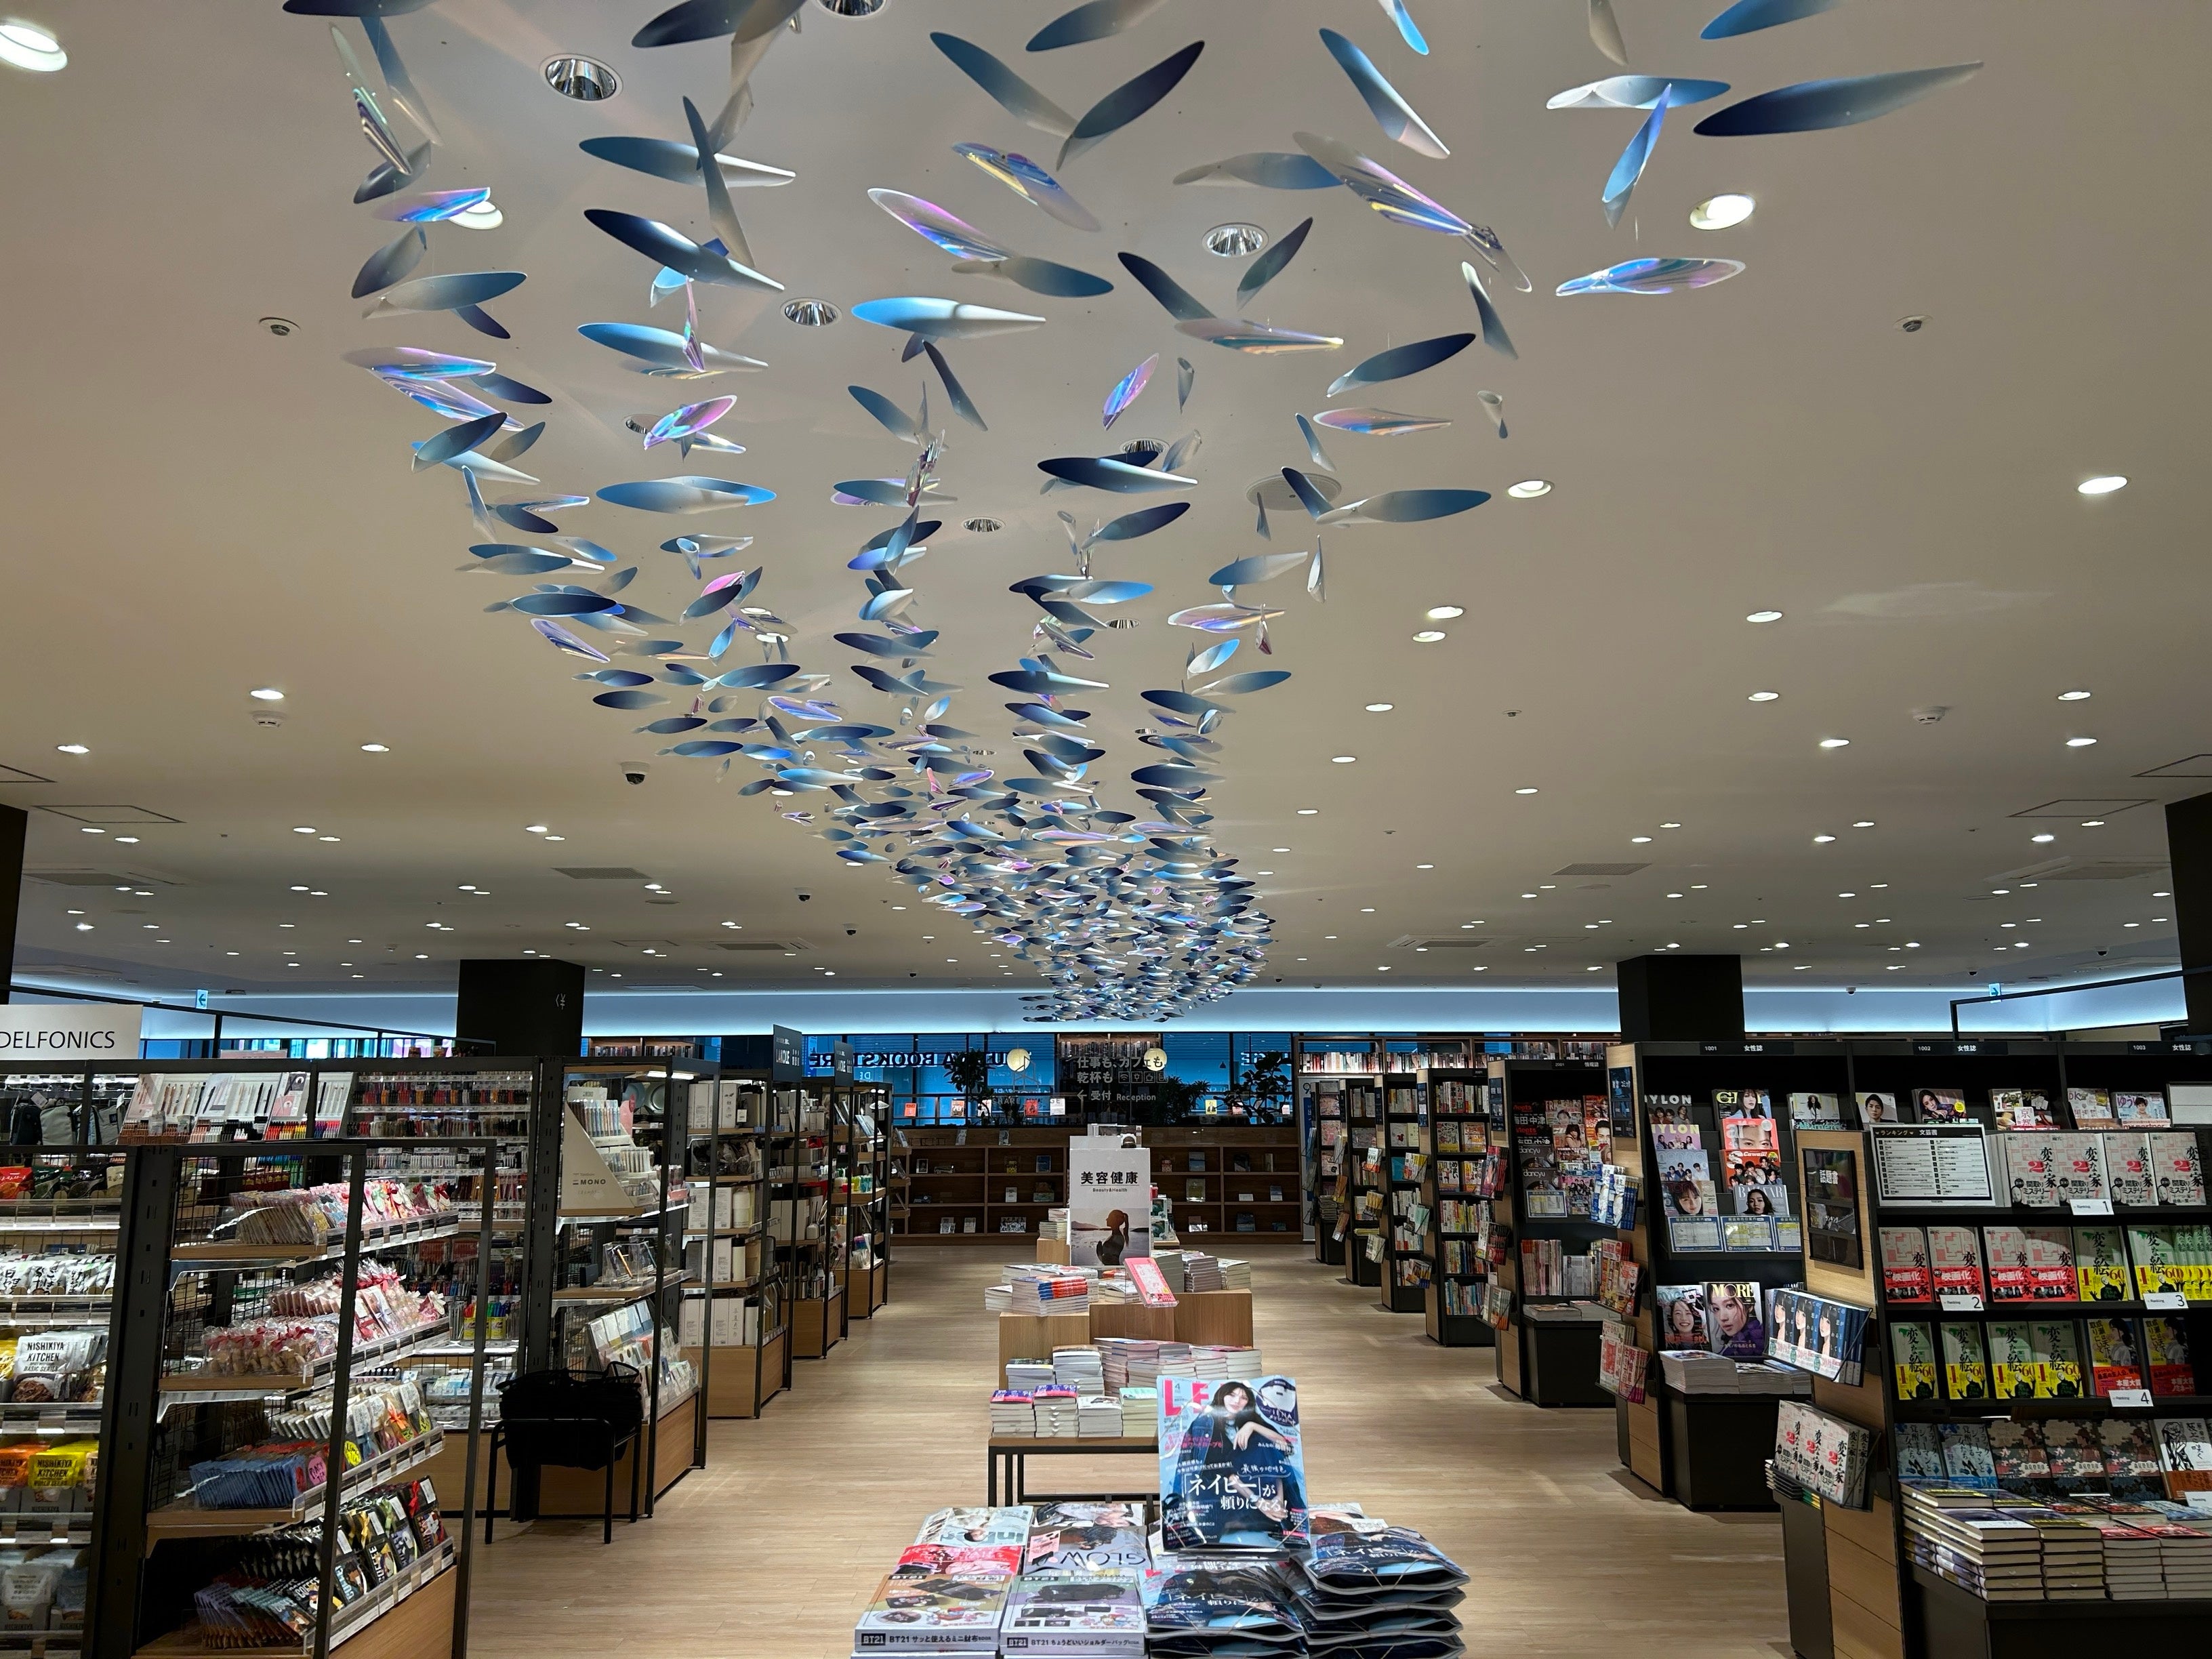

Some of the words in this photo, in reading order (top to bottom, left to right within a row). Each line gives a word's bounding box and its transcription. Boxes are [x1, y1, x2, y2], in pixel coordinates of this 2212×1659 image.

[0, 1031, 115, 1048] DELFONICS
[1957, 1044, 1977, 1052] 女性誌
[2172, 1044, 2192, 1052] 女性誌
[1077, 1071, 1113, 1084] 乾杯も
[1090, 1090, 1111, 1101] 受付
[1116, 1093, 1156, 1102] Reception
[2040, 1147, 2057, 1188] 変な家
[2085, 1147, 2102, 1188] 変な家
[2137, 1146, 2154, 1187] 変な家
[2186, 1146, 2204, 1187] 変な家
[1081, 1171, 1139, 1185] 美容健康
[1523, 1170, 1545, 1178] dancyu
[2102, 1200, 2109, 1213] 1
[2092, 1231, 2110, 1275] 変な絵
[2146, 1230, 2165, 1274] 変な絵
[1971, 1296, 1982, 1309] 2
[2175, 1294, 2186, 1307] 3
[27, 1342, 64, 1351] NISHIKIYA
[1907, 1327, 1923, 1373] 変な絵
[1957, 1327, 1973, 1373] 変な絵
[2005, 1327, 2023, 1372] 変な絵
[2047, 1326, 2065, 1372] 変な絵
[27, 1353, 60, 1362] KITCHEN
[2140, 1391, 2150, 1405] 4
[37, 1459, 73, 1468] NISHIKIYA
[37, 1469, 68, 1477] KITCHEN
[1061, 1551, 1146, 1568] GLOW
[863, 1635, 885, 1645] BT21
[1008, 1638, 1027, 1647] BT21
